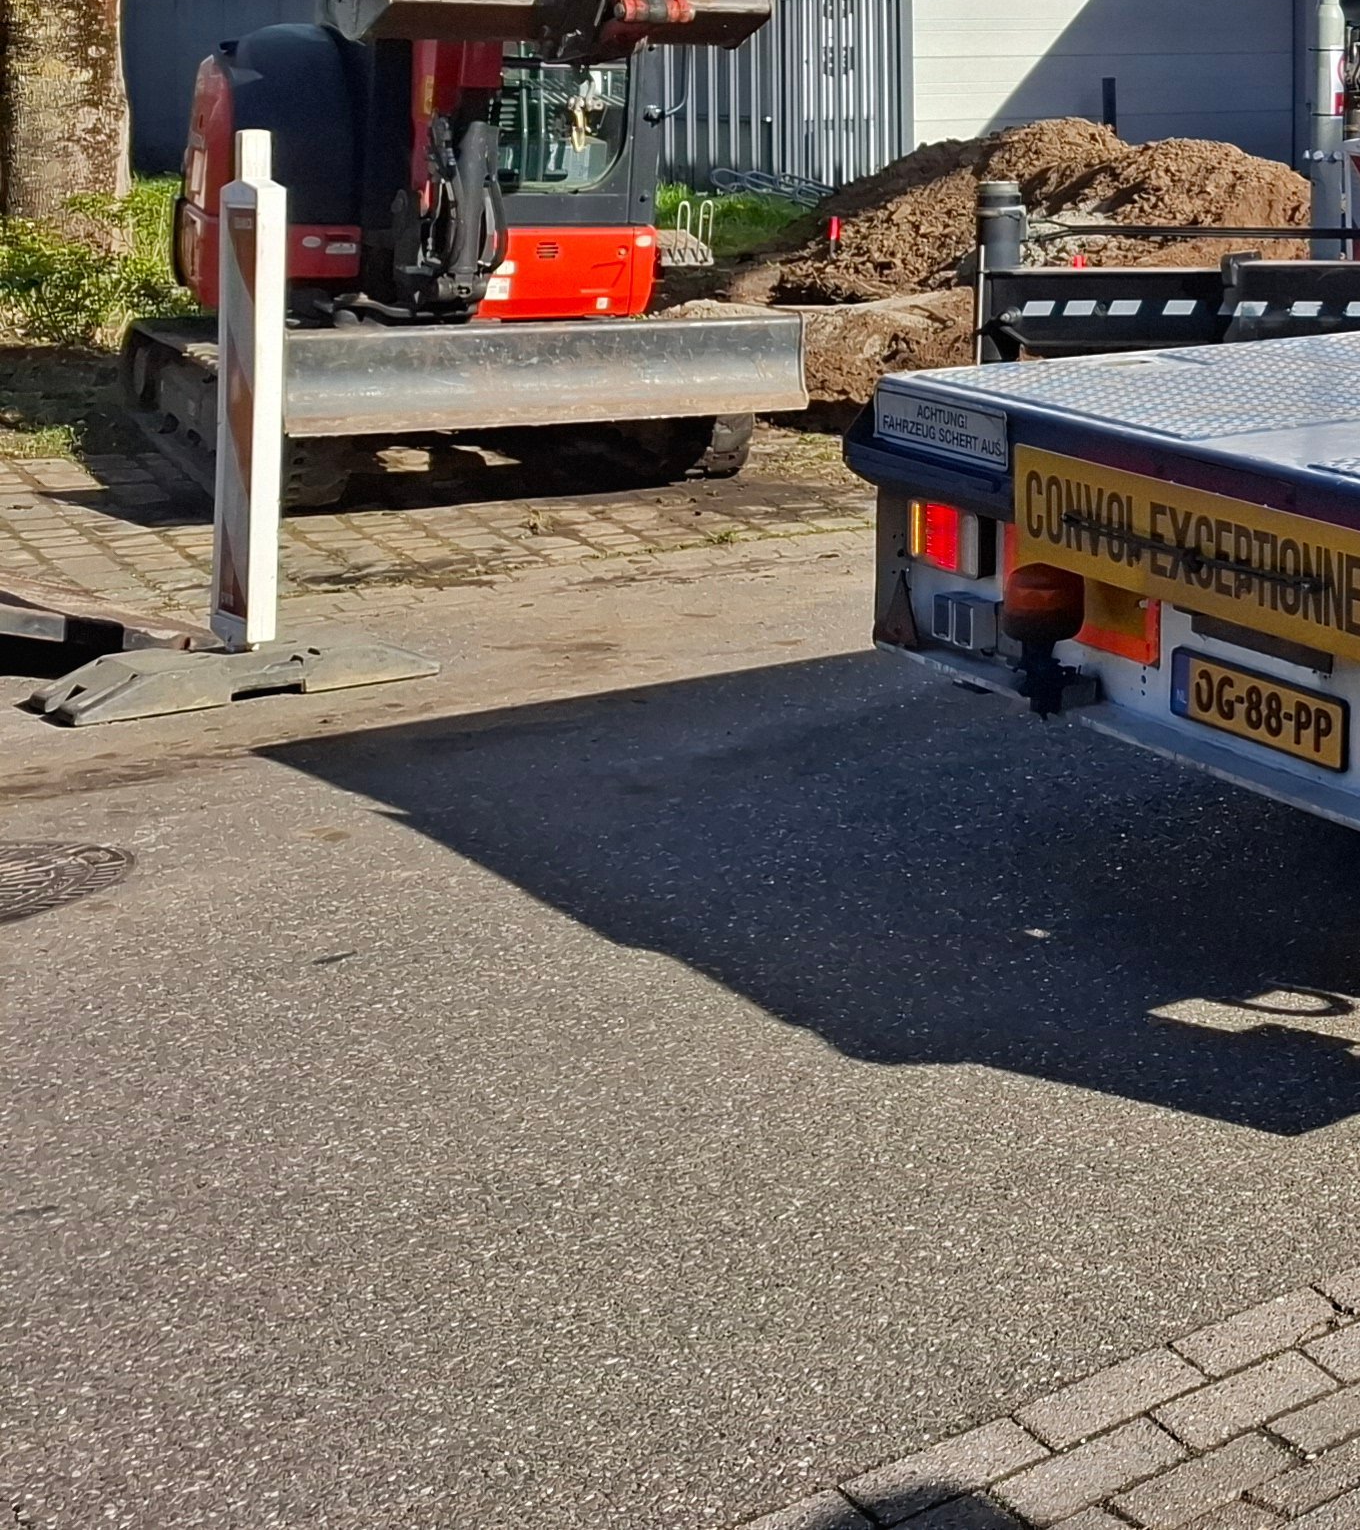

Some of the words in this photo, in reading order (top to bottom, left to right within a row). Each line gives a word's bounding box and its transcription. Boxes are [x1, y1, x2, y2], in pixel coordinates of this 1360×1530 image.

[882, 415, 936, 440] FAHRZEUG
[938, 428, 979, 451] SCHERT
[917, 405, 968, 430] ACHTUNG!
[1026, 470, 1134, 568] CONVOI
[1195, 669, 1332, 753] OG-88-PP
